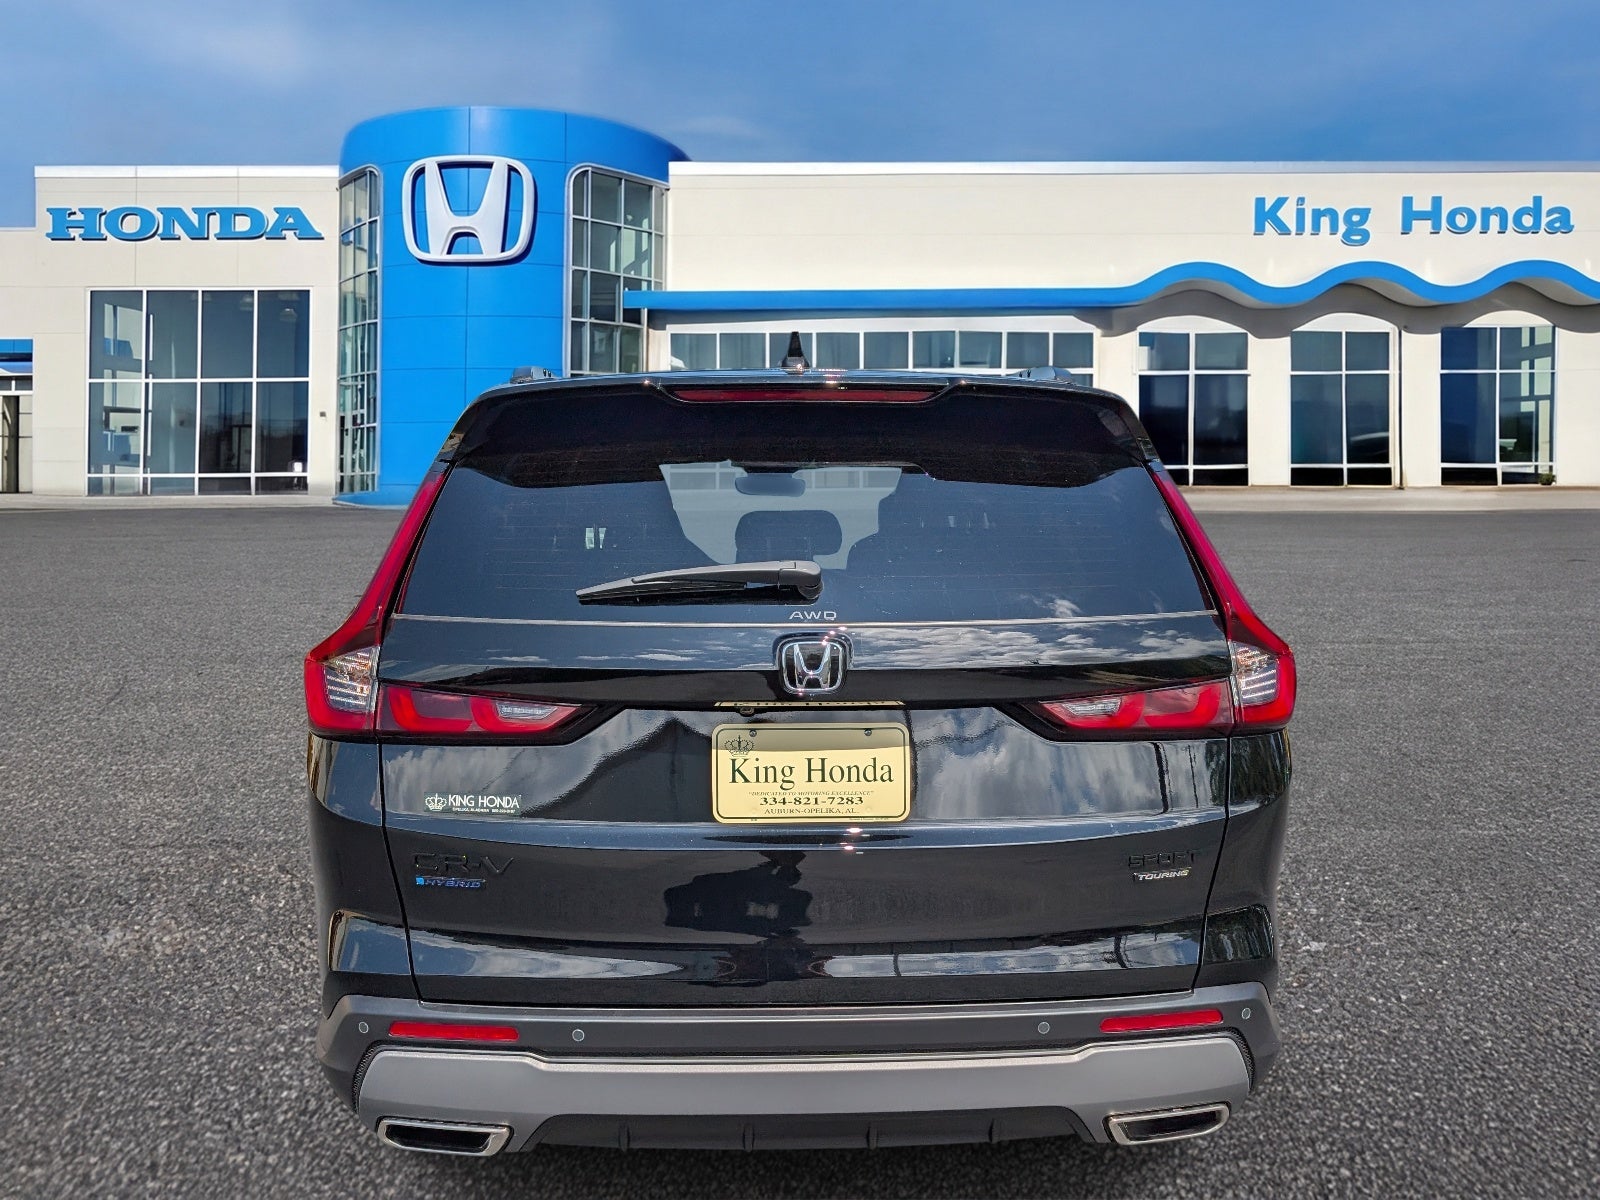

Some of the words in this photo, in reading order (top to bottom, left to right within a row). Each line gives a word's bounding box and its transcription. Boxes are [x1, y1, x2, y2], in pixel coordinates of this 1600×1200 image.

[45, 206, 325, 242] HONDA
[1253, 196, 1372, 246] King
[1400, 195, 1575, 234] Honda
[788, 610, 838, 621] AWD
[729, 757, 795, 791] King
[804, 757, 894, 783] Honda
[448, 794, 475, 807] KING
[478, 796, 520, 809] HONDA
[759, 796, 864, 806] 334-821-7283
[412, 852, 514, 874] CR-V
[1138, 869, 1190, 881] TOURING
[425, 879, 481, 888] HYBRID
